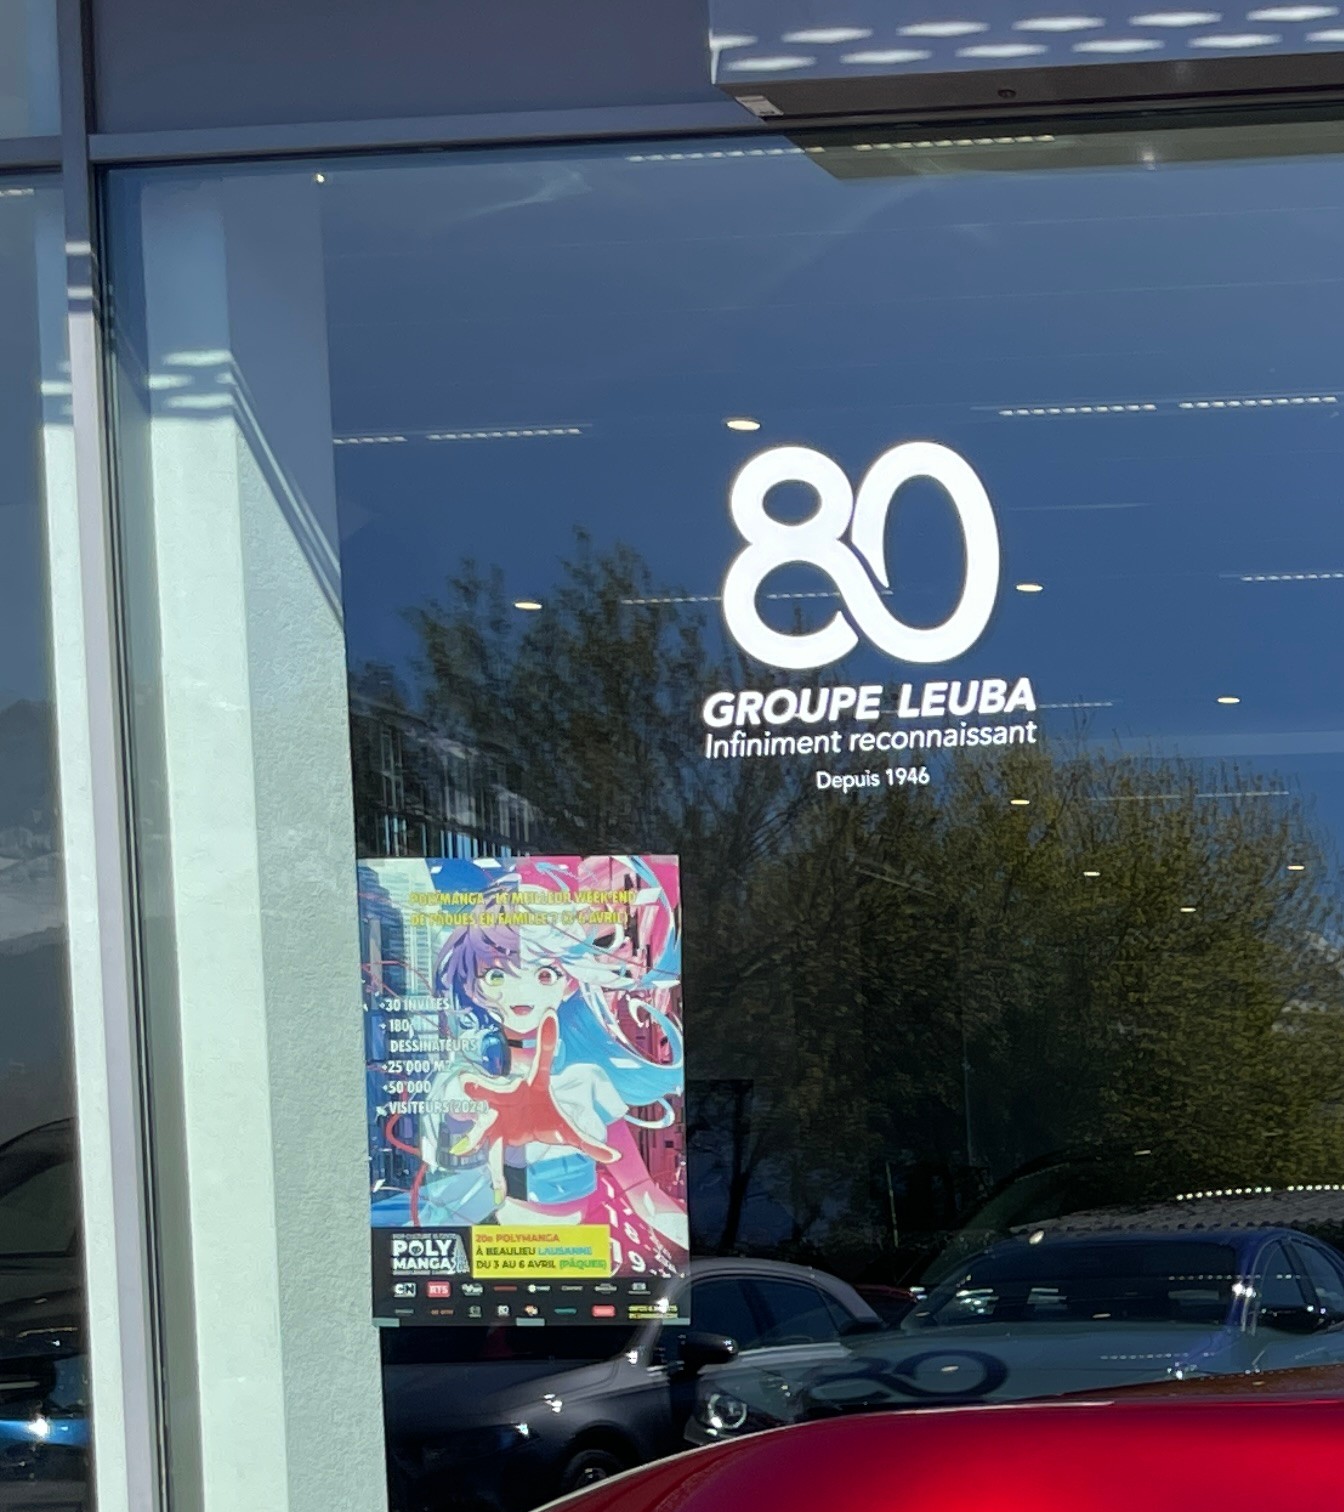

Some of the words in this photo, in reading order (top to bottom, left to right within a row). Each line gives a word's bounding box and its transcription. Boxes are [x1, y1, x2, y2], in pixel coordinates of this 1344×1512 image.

[722, 441, 1000, 670] 80
[703, 684, 883, 728] GROUPE
[896, 676, 1037, 719] LEUBA
[705, 731, 841, 759] Infiniment
[849, 720, 1038, 752] reconnaissant
[816, 770, 880, 794] Depuis
[886, 766, 931, 785] 1946
[390, 1038, 479, 1053] DESSINATEURS
[392, 1238, 453, 1258] POLY
[392, 1257, 451, 1271] MANGA
[476, 1260, 490, 1270] DU
[502, 1259, 517, 1269] AU
[527, 1259, 556, 1269] AVRIL
[428, 1284, 450, 1295] RTS
